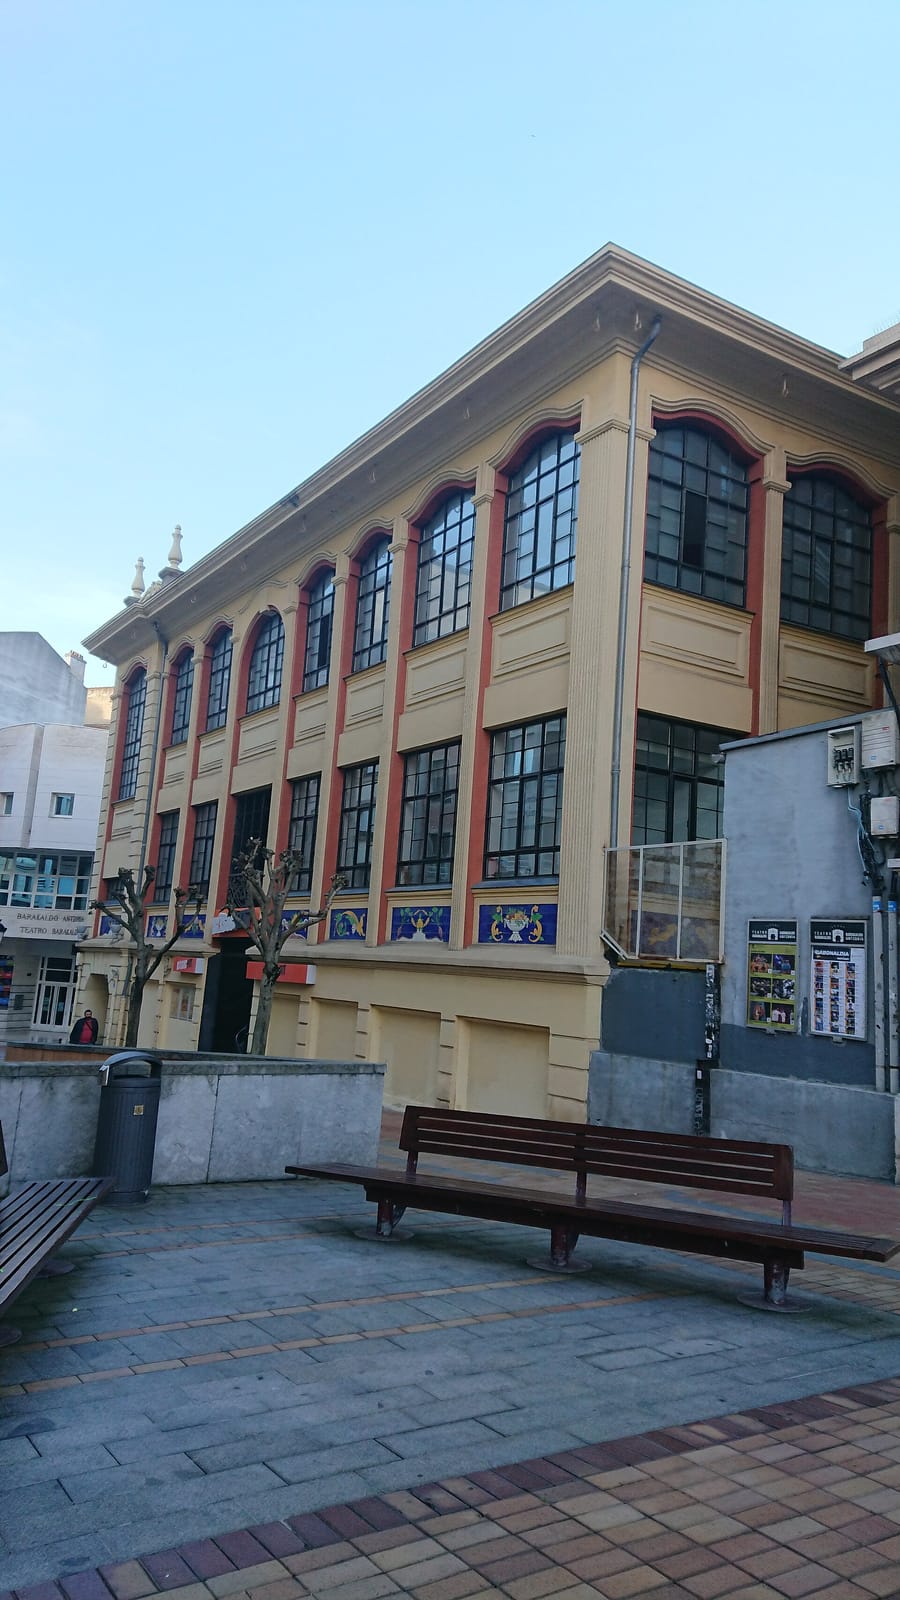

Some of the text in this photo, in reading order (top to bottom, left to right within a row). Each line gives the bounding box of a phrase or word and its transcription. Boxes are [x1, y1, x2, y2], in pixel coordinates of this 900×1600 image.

[17, 913, 58, 922] BARAKALDO
[20, 926, 77, 936] TEATRO BARAKAL
